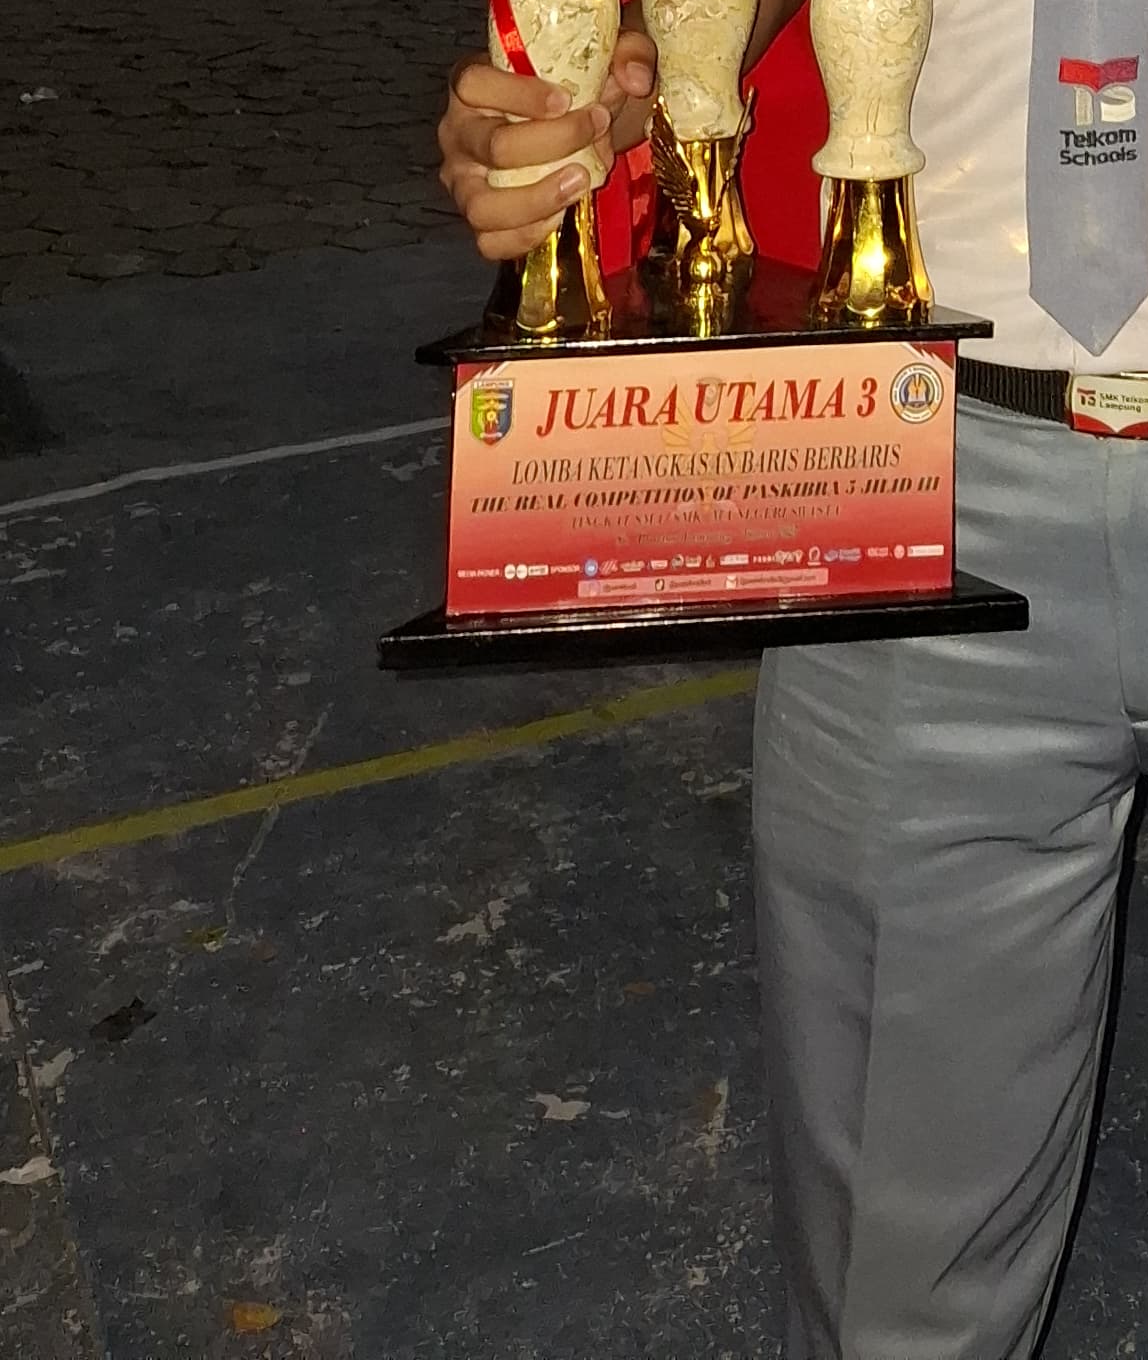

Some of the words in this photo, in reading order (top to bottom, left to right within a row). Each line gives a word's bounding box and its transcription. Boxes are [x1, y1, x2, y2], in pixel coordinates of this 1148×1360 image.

[1059, 128, 1137, 149] Telkom
[1059, 146, 1138, 167] Schools
[535, 383, 680, 438] JUARA
[693, 377, 847, 424] UTAMA
[856, 376, 878, 418] 3
[511, 455, 583, 486] LOMBA
[588, 450, 738, 483] KETANGKASAN
[740, 447, 800, 474] BARIS
[803, 443, 902, 472] BERBARIS
[470, 496, 510, 514] THE
[514, 492, 568, 512] REAL
[573, 487, 707, 509] COMPETITION
[711, 485, 740, 502] OF
[742, 480, 841, 501] PASKIBRA
